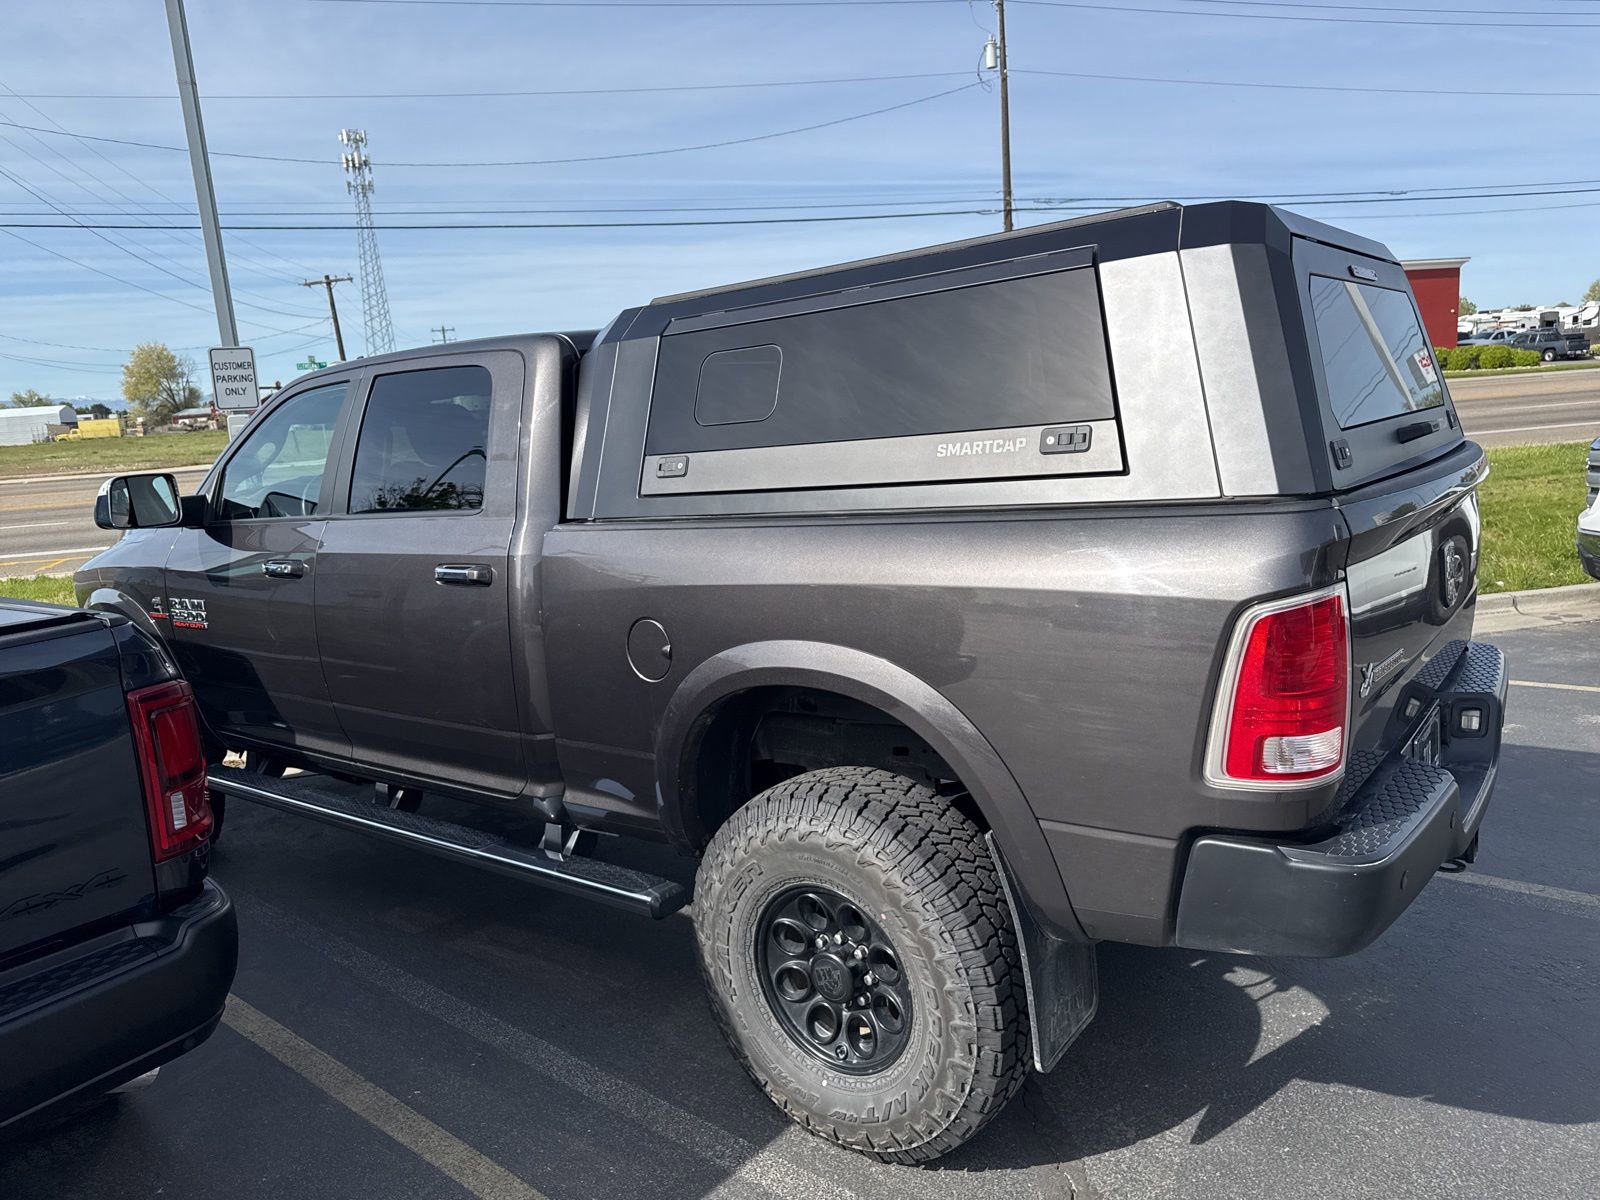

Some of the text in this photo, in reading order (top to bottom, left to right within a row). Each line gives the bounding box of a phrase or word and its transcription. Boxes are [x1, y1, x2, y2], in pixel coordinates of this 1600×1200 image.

[213, 361, 253, 371] CUSTOMER
[216, 374, 254, 383] PARKING
[224, 387, 247, 396] ONLY
[936, 437, 1027, 458] SMARTCAP
[169, 597, 205, 611] RAM
[171, 609, 207, 622] 2500
